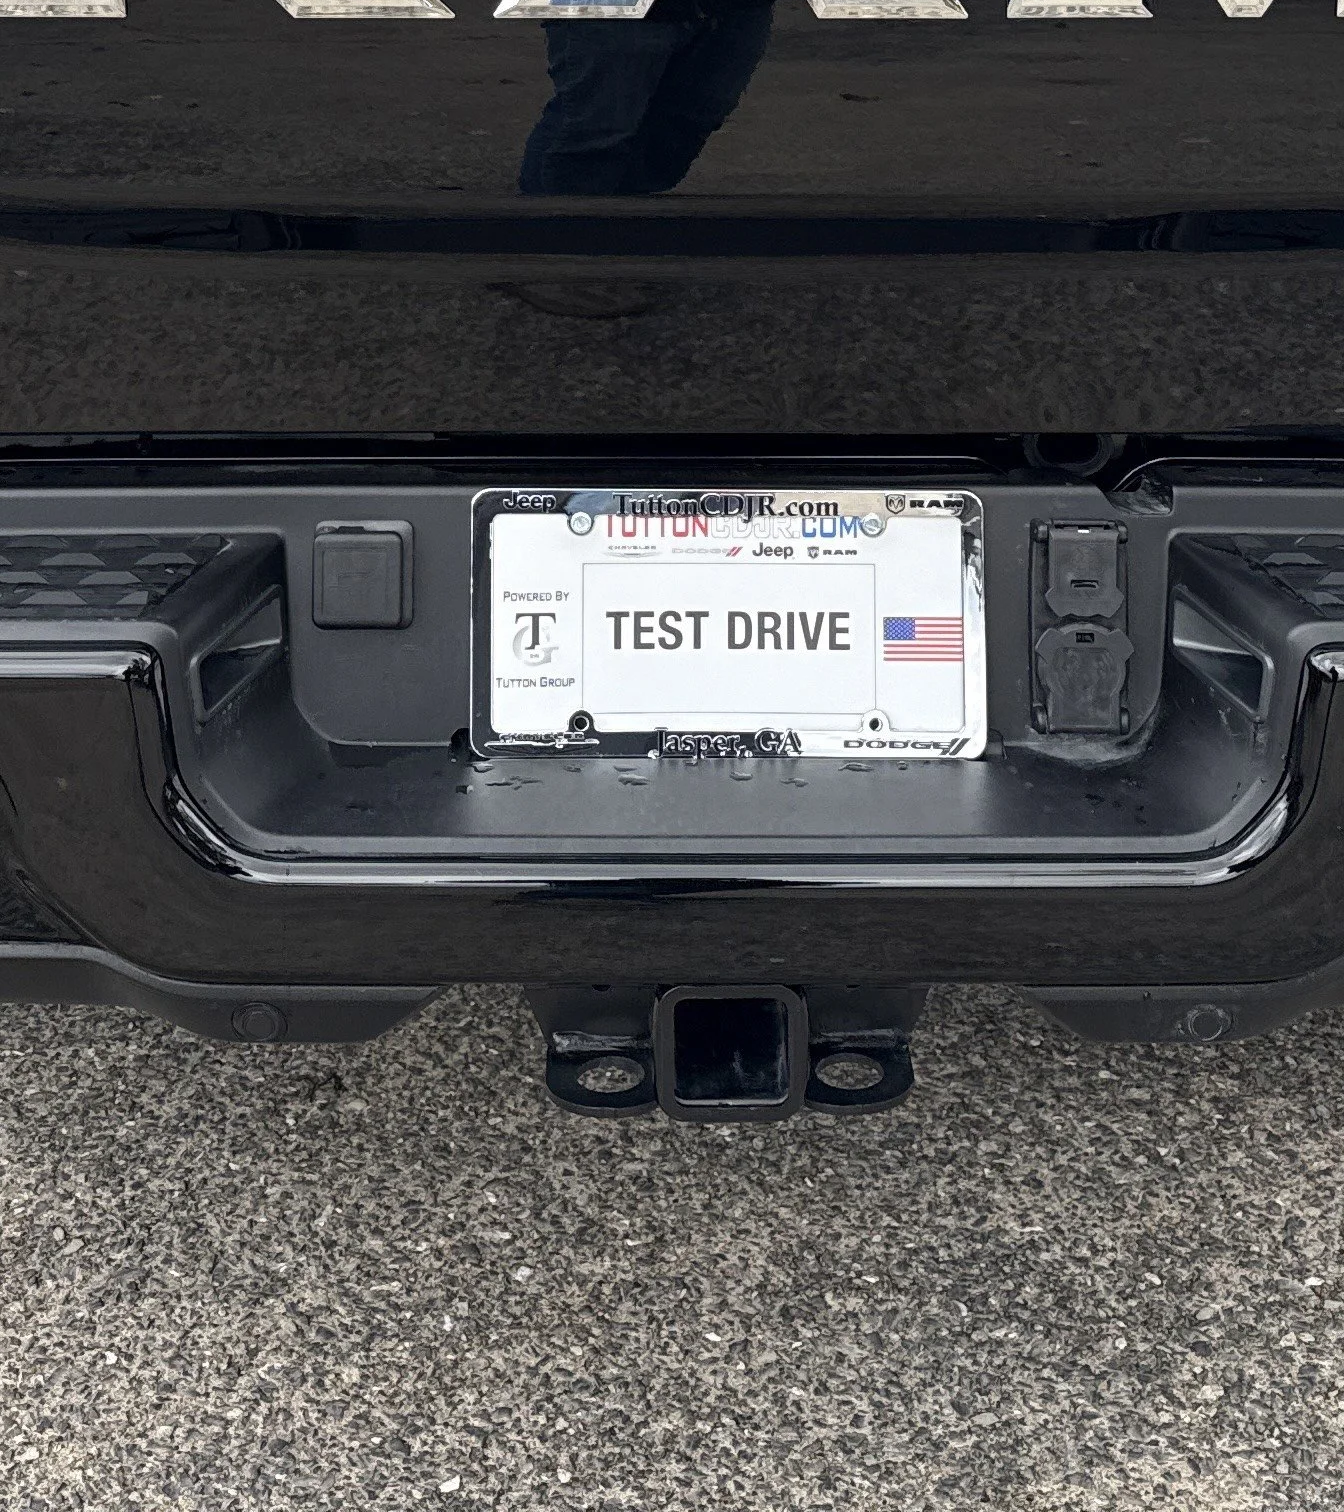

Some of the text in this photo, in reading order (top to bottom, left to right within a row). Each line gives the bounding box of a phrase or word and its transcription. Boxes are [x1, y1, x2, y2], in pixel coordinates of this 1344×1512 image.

[502, 490, 557, 514] Jeep
[612, 492, 840, 523] TuttonCDJR.com
[909, 498, 964, 510] RAM
[752, 542, 795, 560] Jeep
[822, 549, 858, 557] RAM
[606, 610, 851, 651] TEST DRIVE
[653, 726, 803, 763] Jasper, GA
